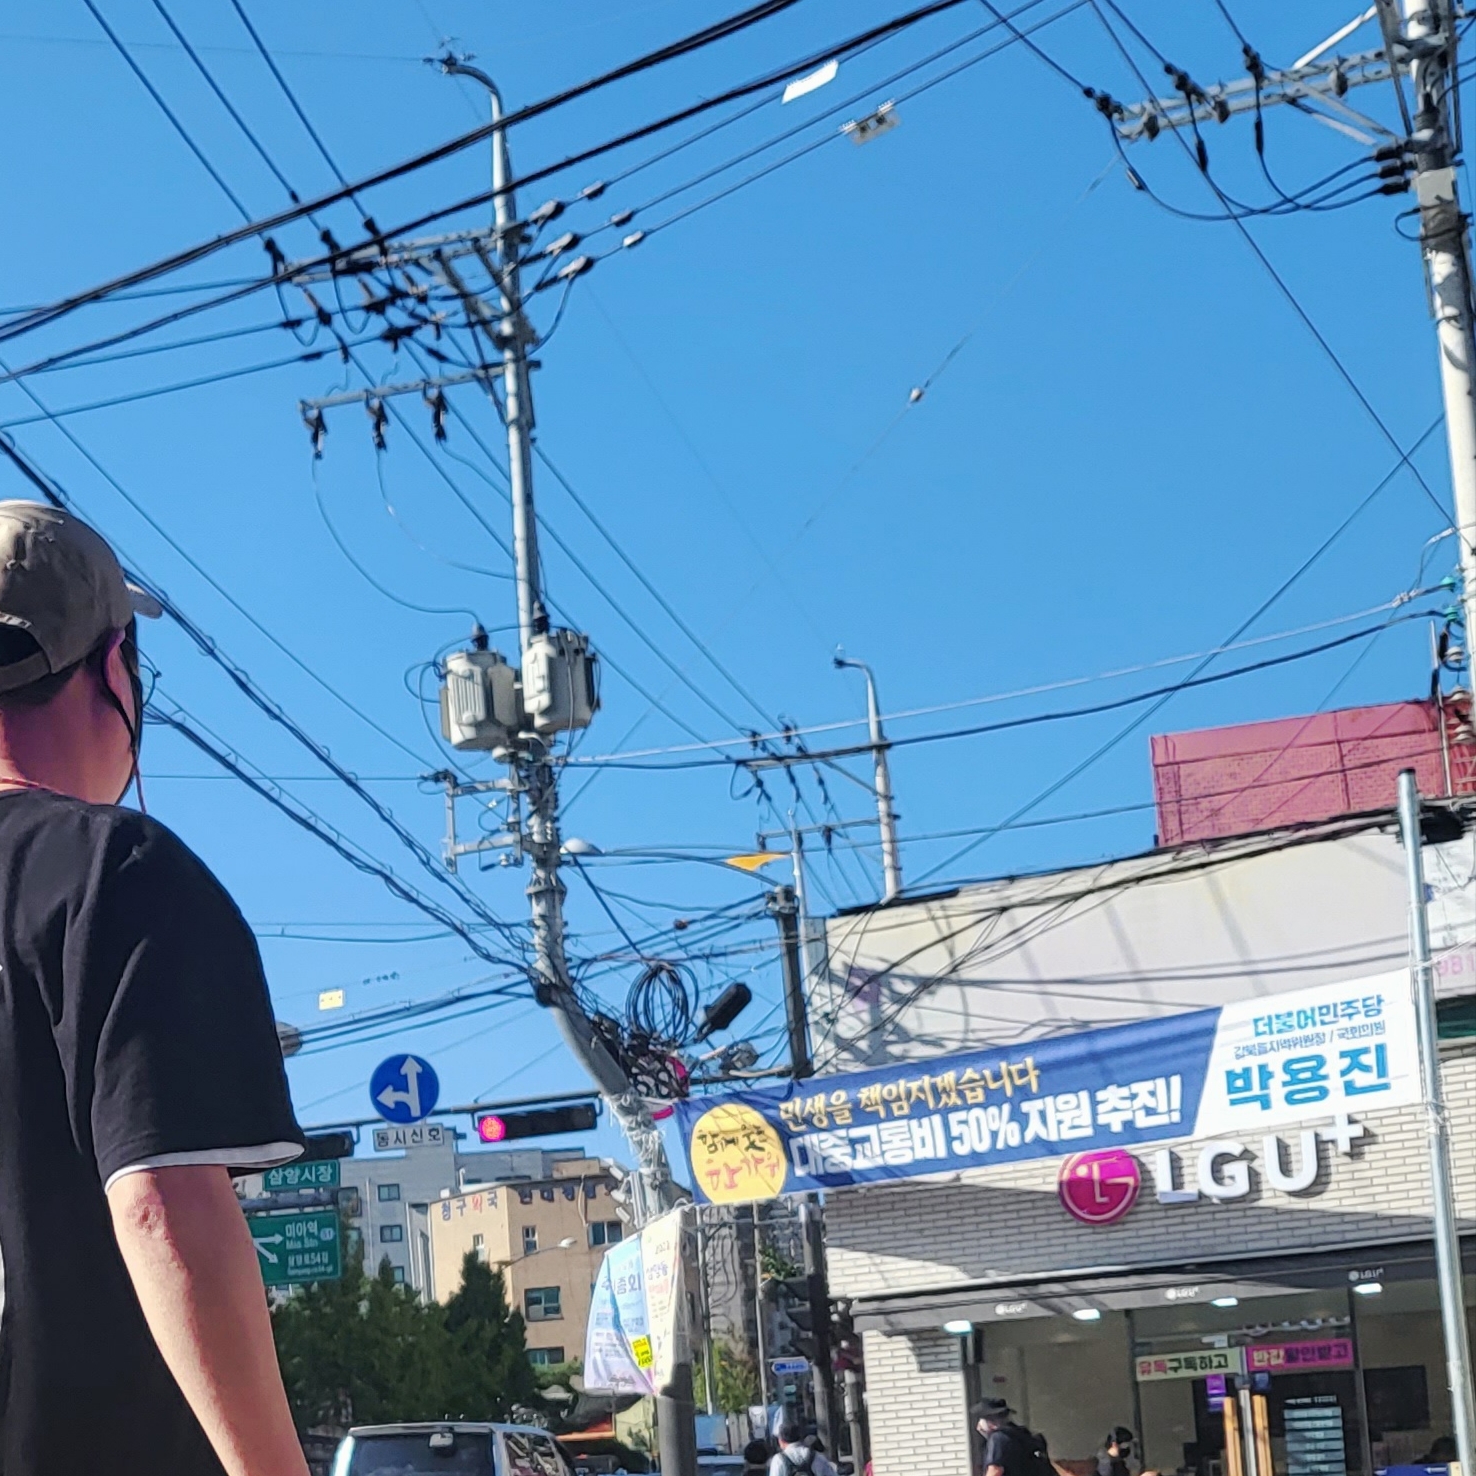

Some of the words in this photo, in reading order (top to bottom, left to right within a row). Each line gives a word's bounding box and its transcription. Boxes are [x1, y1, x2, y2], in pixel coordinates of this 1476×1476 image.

[1252, 994, 1386, 1037] 더불어민주당
[778, 1088, 854, 1133] 민생을
[857, 1056, 1040, 1119] 책임지겠습니다
[1224, 1042, 1392, 1112] 박용진
[788, 1113, 949, 1177] 대중교통비
[948, 1101, 1022, 1158] 50%
[1019, 1089, 1095, 1144] 지원
[1095, 1073, 1182, 1134] 추진!
[268, 1164, 334, 1186] 삼양시장
